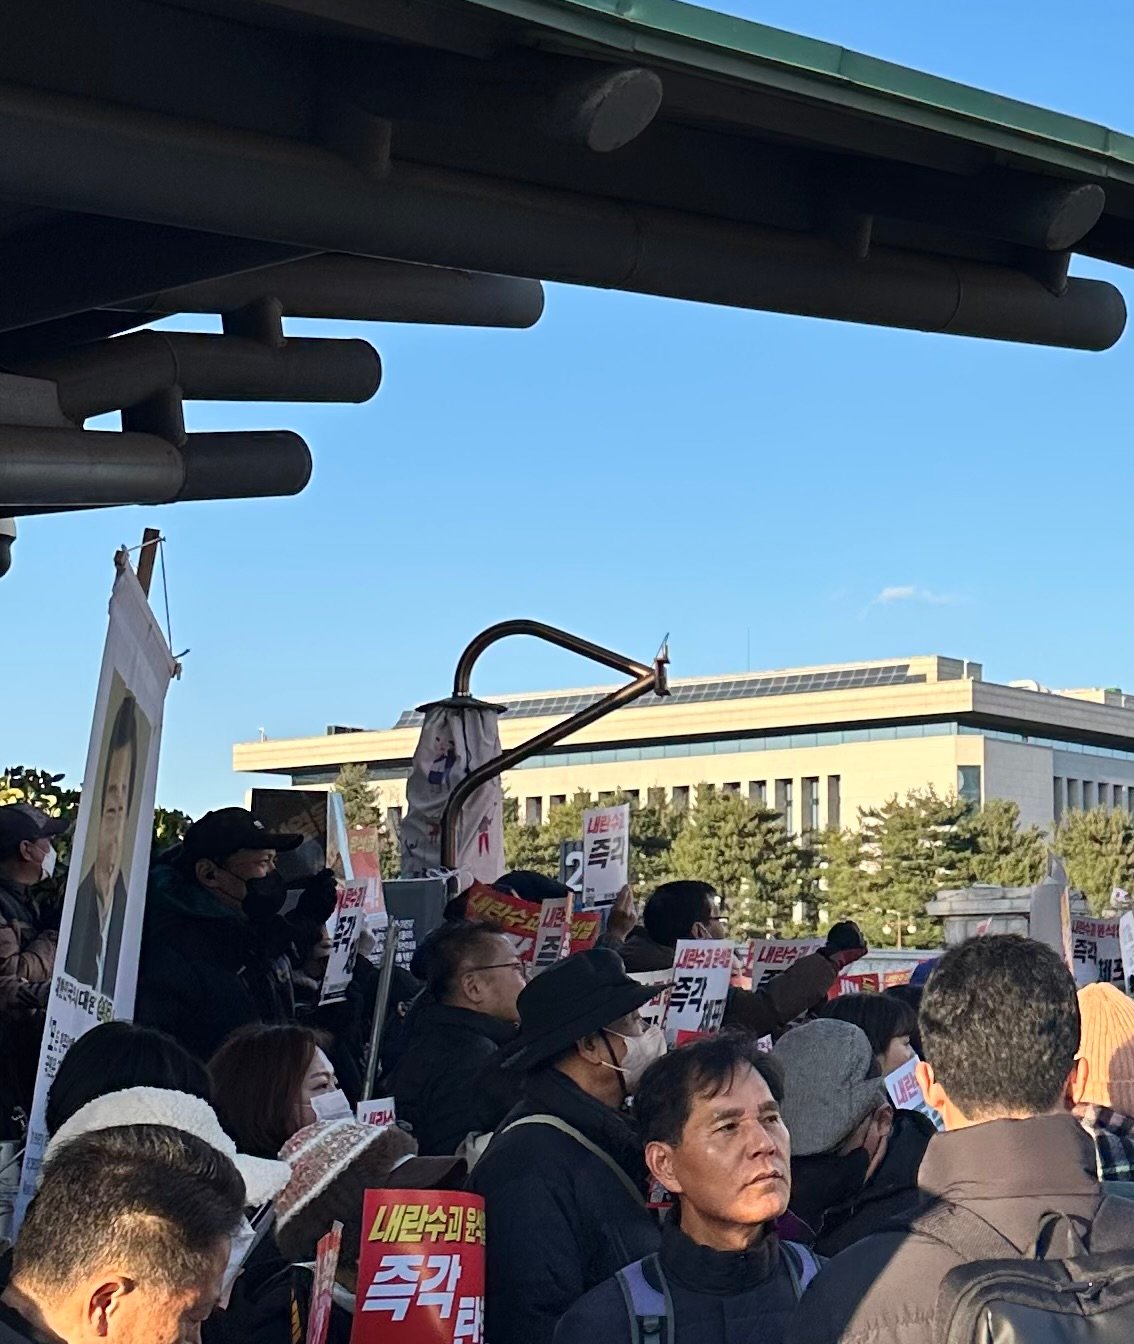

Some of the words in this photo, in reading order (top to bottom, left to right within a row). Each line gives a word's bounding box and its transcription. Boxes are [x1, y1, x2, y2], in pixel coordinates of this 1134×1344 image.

[671, 976, 707, 1012] 즉각
[368, 1205, 463, 1243] 내란수괴
[361, 1254, 462, 1321] 즉각
